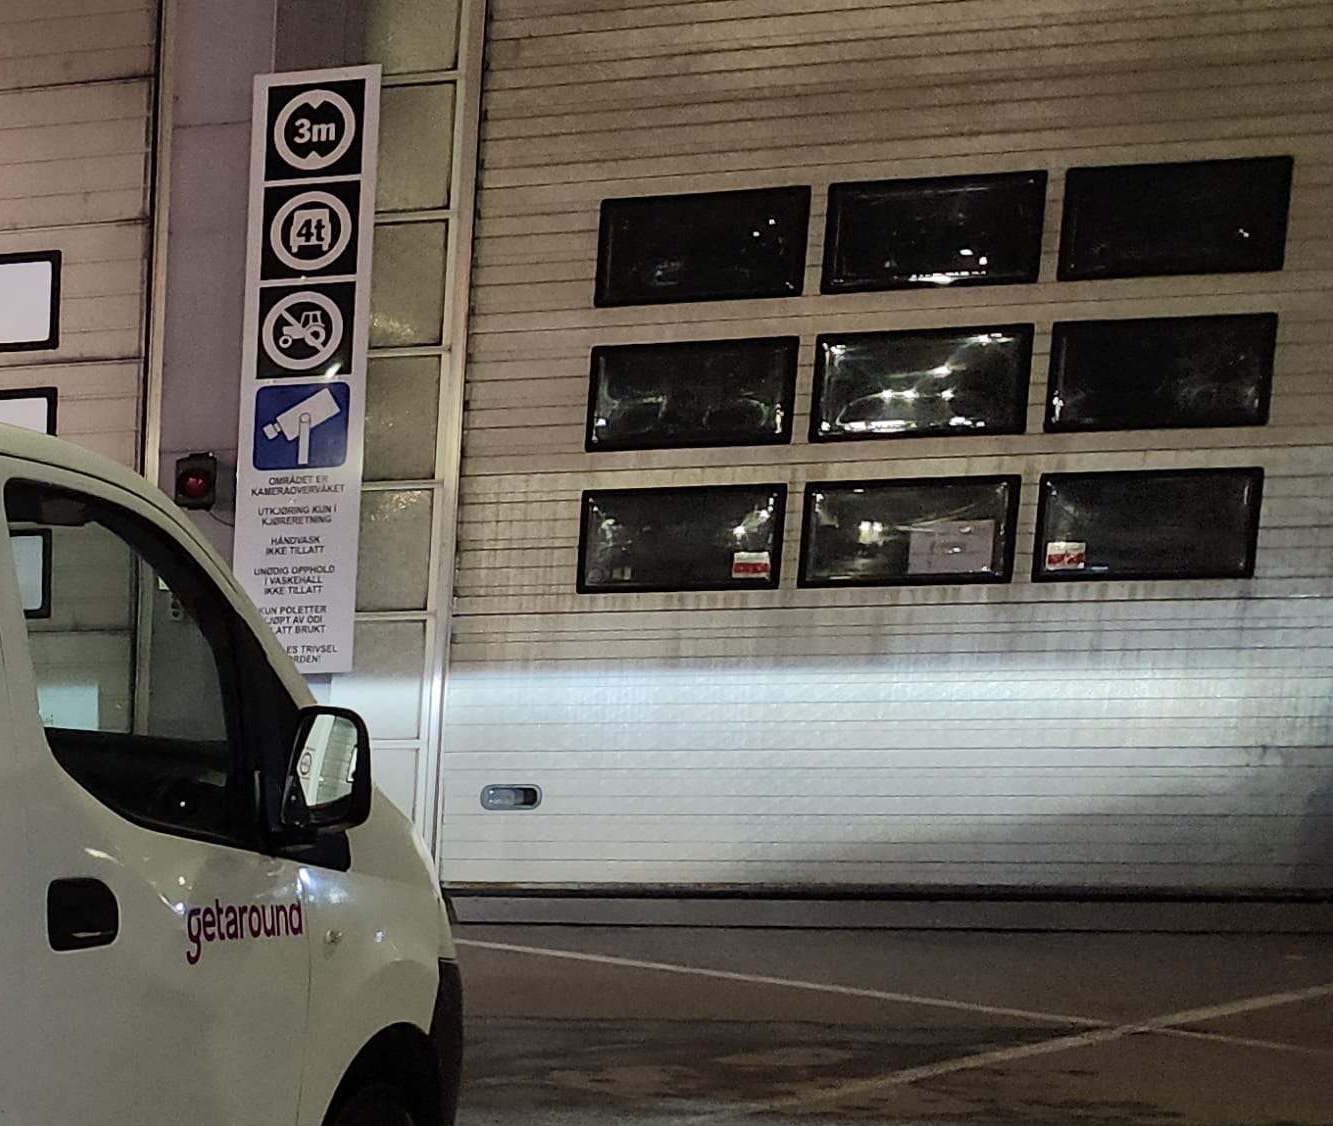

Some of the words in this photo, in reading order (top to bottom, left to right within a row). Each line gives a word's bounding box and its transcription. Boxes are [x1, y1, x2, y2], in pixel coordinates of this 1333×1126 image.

[293, 118, 336, 144] 3m
[296, 218, 326, 243] 4t
[268, 474, 313, 486] OMRÅDET
[251, 484, 345, 496] KAMERAOVERVÅKET
[258, 505, 310, 516] UTKJØRING
[312, 504, 332, 514] KUN
[261, 515, 332, 526] KJØRERETNING
[271, 535, 321, 545] HÅNDVASK
[265, 546, 287, 556] IKKE
[290, 545, 325, 555] TILLATT
[254, 566, 289, 576] UNØDIG
[291, 564, 335, 575] OPPHOLD
[269, 575, 323, 585] VASKEHALL
[264, 586, 286, 596] IKKE
[288, 585, 323, 595] TILLATT
[280, 605, 327, 615] POLETTER
[292, 615, 306, 624] AV
[295, 624, 326, 635] BRUKT
[301, 644, 338, 654] TRIVSEL
[186, 898, 303, 965] getaround
